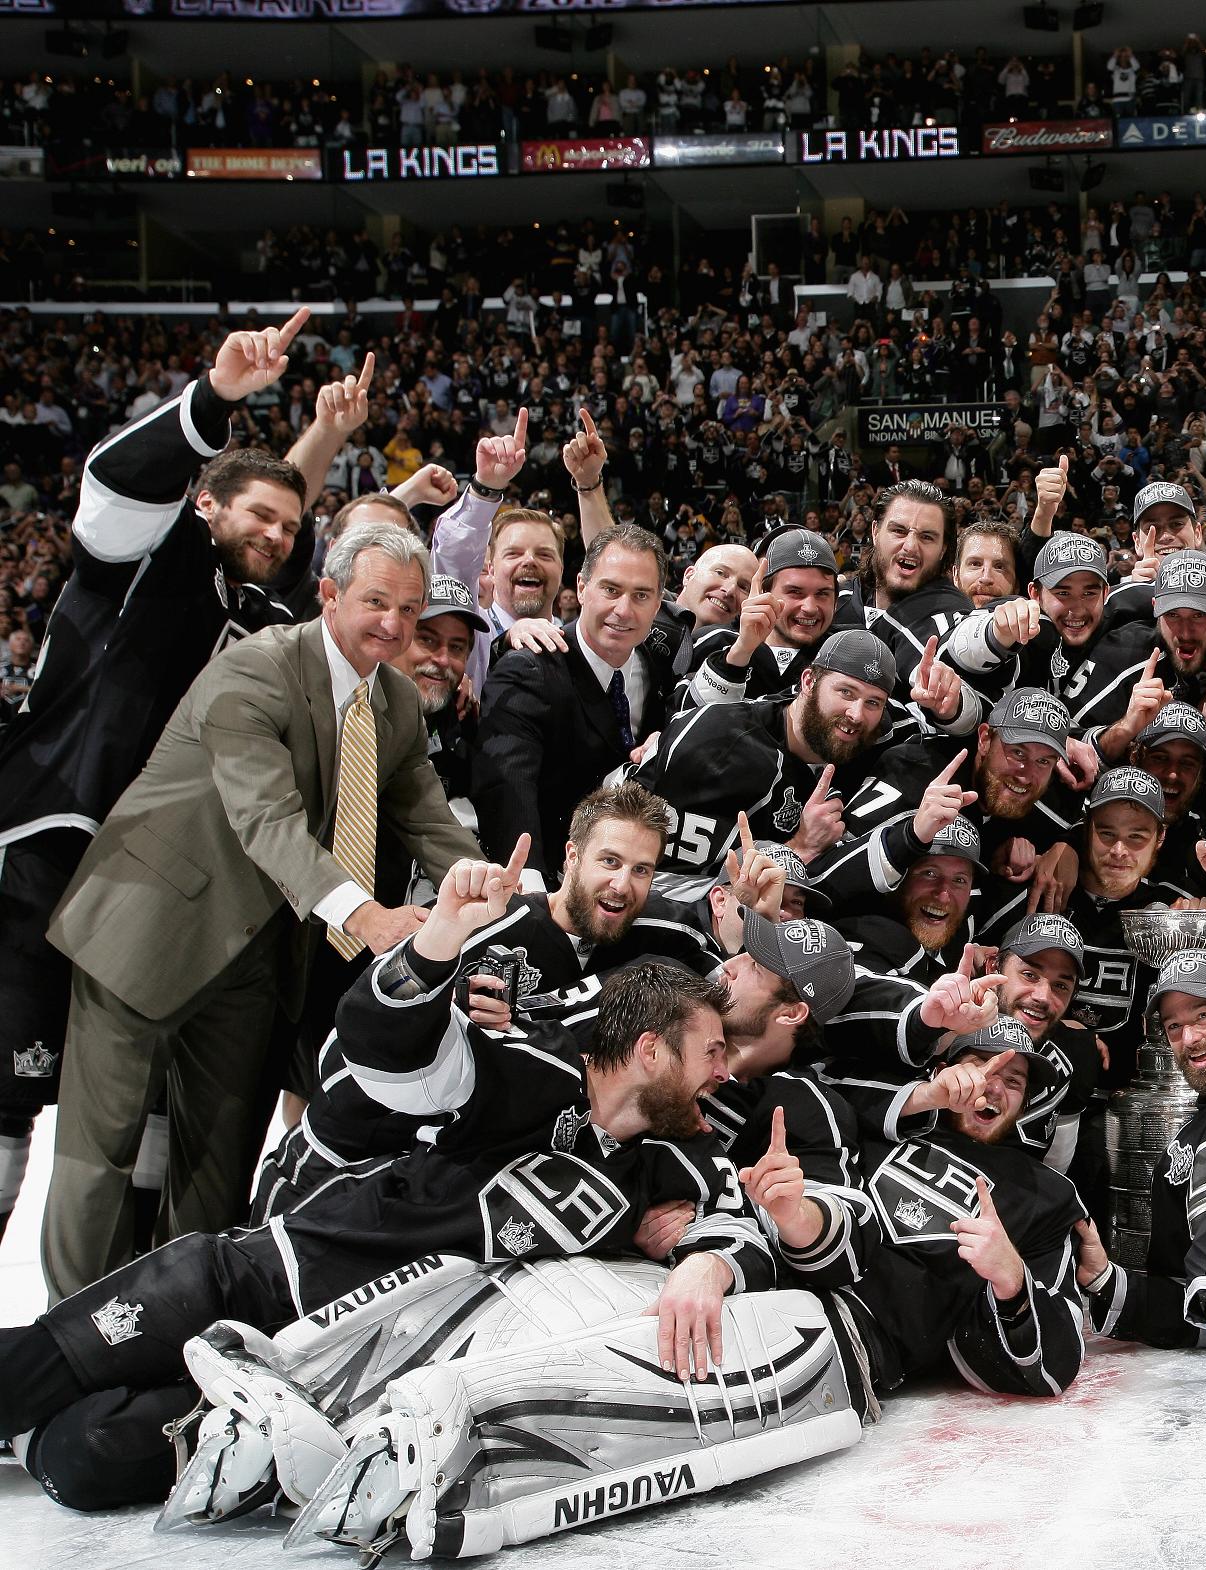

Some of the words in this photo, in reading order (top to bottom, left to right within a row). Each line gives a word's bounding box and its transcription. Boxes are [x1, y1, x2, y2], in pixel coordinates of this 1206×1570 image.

[802, 130, 847, 162] LA
[860, 126, 960, 160] KINGS
[984, 126, 1112, 150] Budweiser
[106, 154, 182, 173] verion
[343, 148, 389, 180] LA
[399, 144, 500, 178] KINGS
[868, 412, 907, 431] SAN
[923, 409, 1001, 429] MANUEL
[868, 431, 907, 442] INDIAN
[894, 1143, 980, 1208] LA
[515, 1153, 615, 1239] LA
[307, 1253, 445, 1330] VAUGHN
[554, 1463, 696, 1528] VAUGHN
